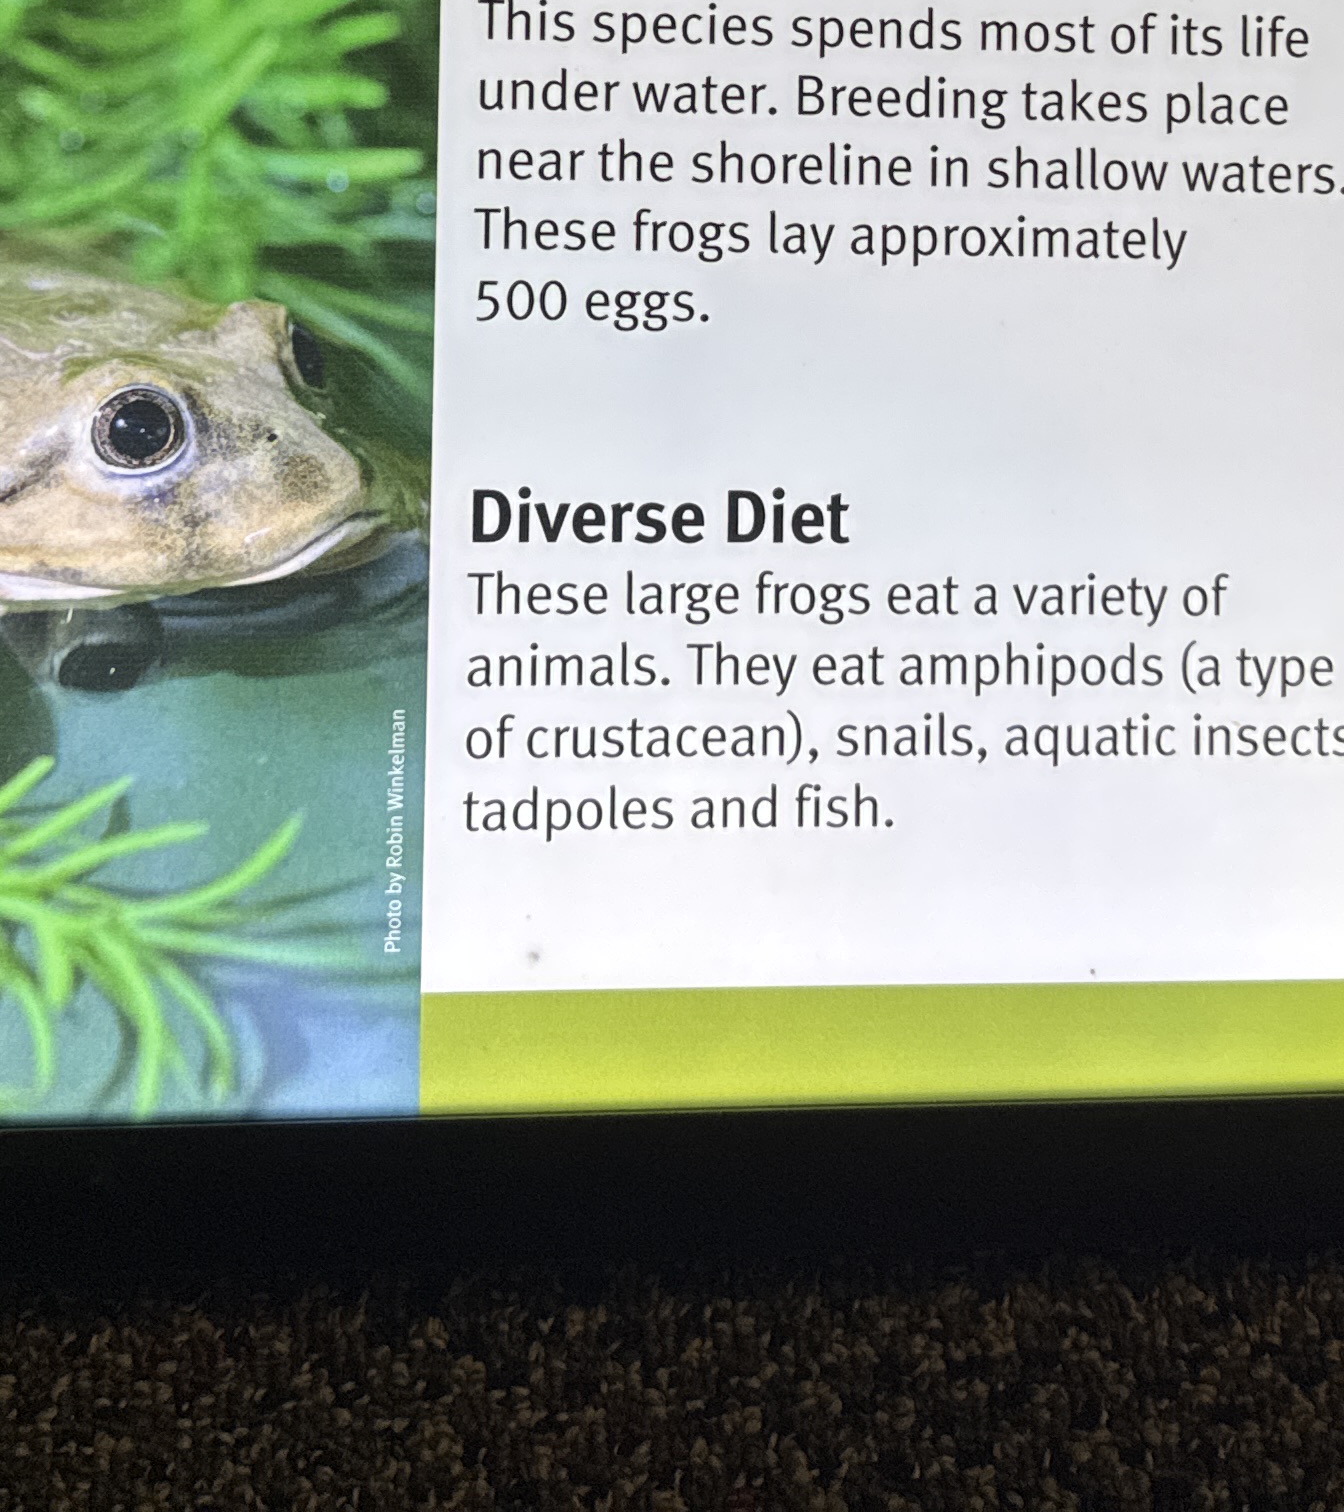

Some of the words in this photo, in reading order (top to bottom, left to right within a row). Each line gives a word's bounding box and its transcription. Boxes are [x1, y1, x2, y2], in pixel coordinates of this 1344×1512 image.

[592, 2, 774, 55] species
[791, 6, 962, 59] spends
[980, 15, 1095, 54] most
[1110, 12, 1158, 55] of
[1170, 13, 1223, 57] its
[1241, 14, 1309, 59] life
[479, 67, 621, 112] under
[632, 75, 777, 116] water.
[797, 74, 1009, 130] Breeding
[1021, 78, 1148, 123] takes
[1166, 81, 1289, 135] place
[478, 148, 586, 182] near
[597, 137, 674, 183] the
[691, 140, 912, 187] shoreline
[930, 144, 968, 188] in
[987, 145, 1169, 191] shallow
[473, 205, 616, 252] These
[632, 208, 750, 263] frogs
[769, 210, 836, 266] lay
[850, 214, 1188, 271] approximately
[476, 279, 567, 322] 500
[585, 289, 710, 332] eggs.
[472, 486, 705, 544] Diverse
[727, 487, 850, 545] Diet
[467, 570, 608, 616] These
[626, 570, 740, 625] large
[755, 570, 871, 625] frogs
[887, 576, 959, 616] eat
[973, 583, 998, 616] a
[1012, 572, 1168, 628] variety
[1182, 572, 1230, 617] of
[467, 641, 670, 688] animals.
[686, 640, 798, 697] They
[812, 646, 885, 686] eat
[899, 641, 1164, 697] amphipods
[1181, 640, 1221, 695] (a
[1235, 647, 1334, 698] type
[386, 709, 406, 812] Winkelman
[466, 713, 516, 760] of
[526, 709, 819, 766] crustacean),
[836, 711, 987, 764] snails,
[1004, 712, 1176, 767] aquatic
[385, 815, 404, 868] Robin
[462, 784, 674, 843] tadpoles
[690, 783, 777, 829] and
[795, 782, 894, 828] fish.
[384, 871, 407, 895] by
[383, 899, 403, 953] Photo
